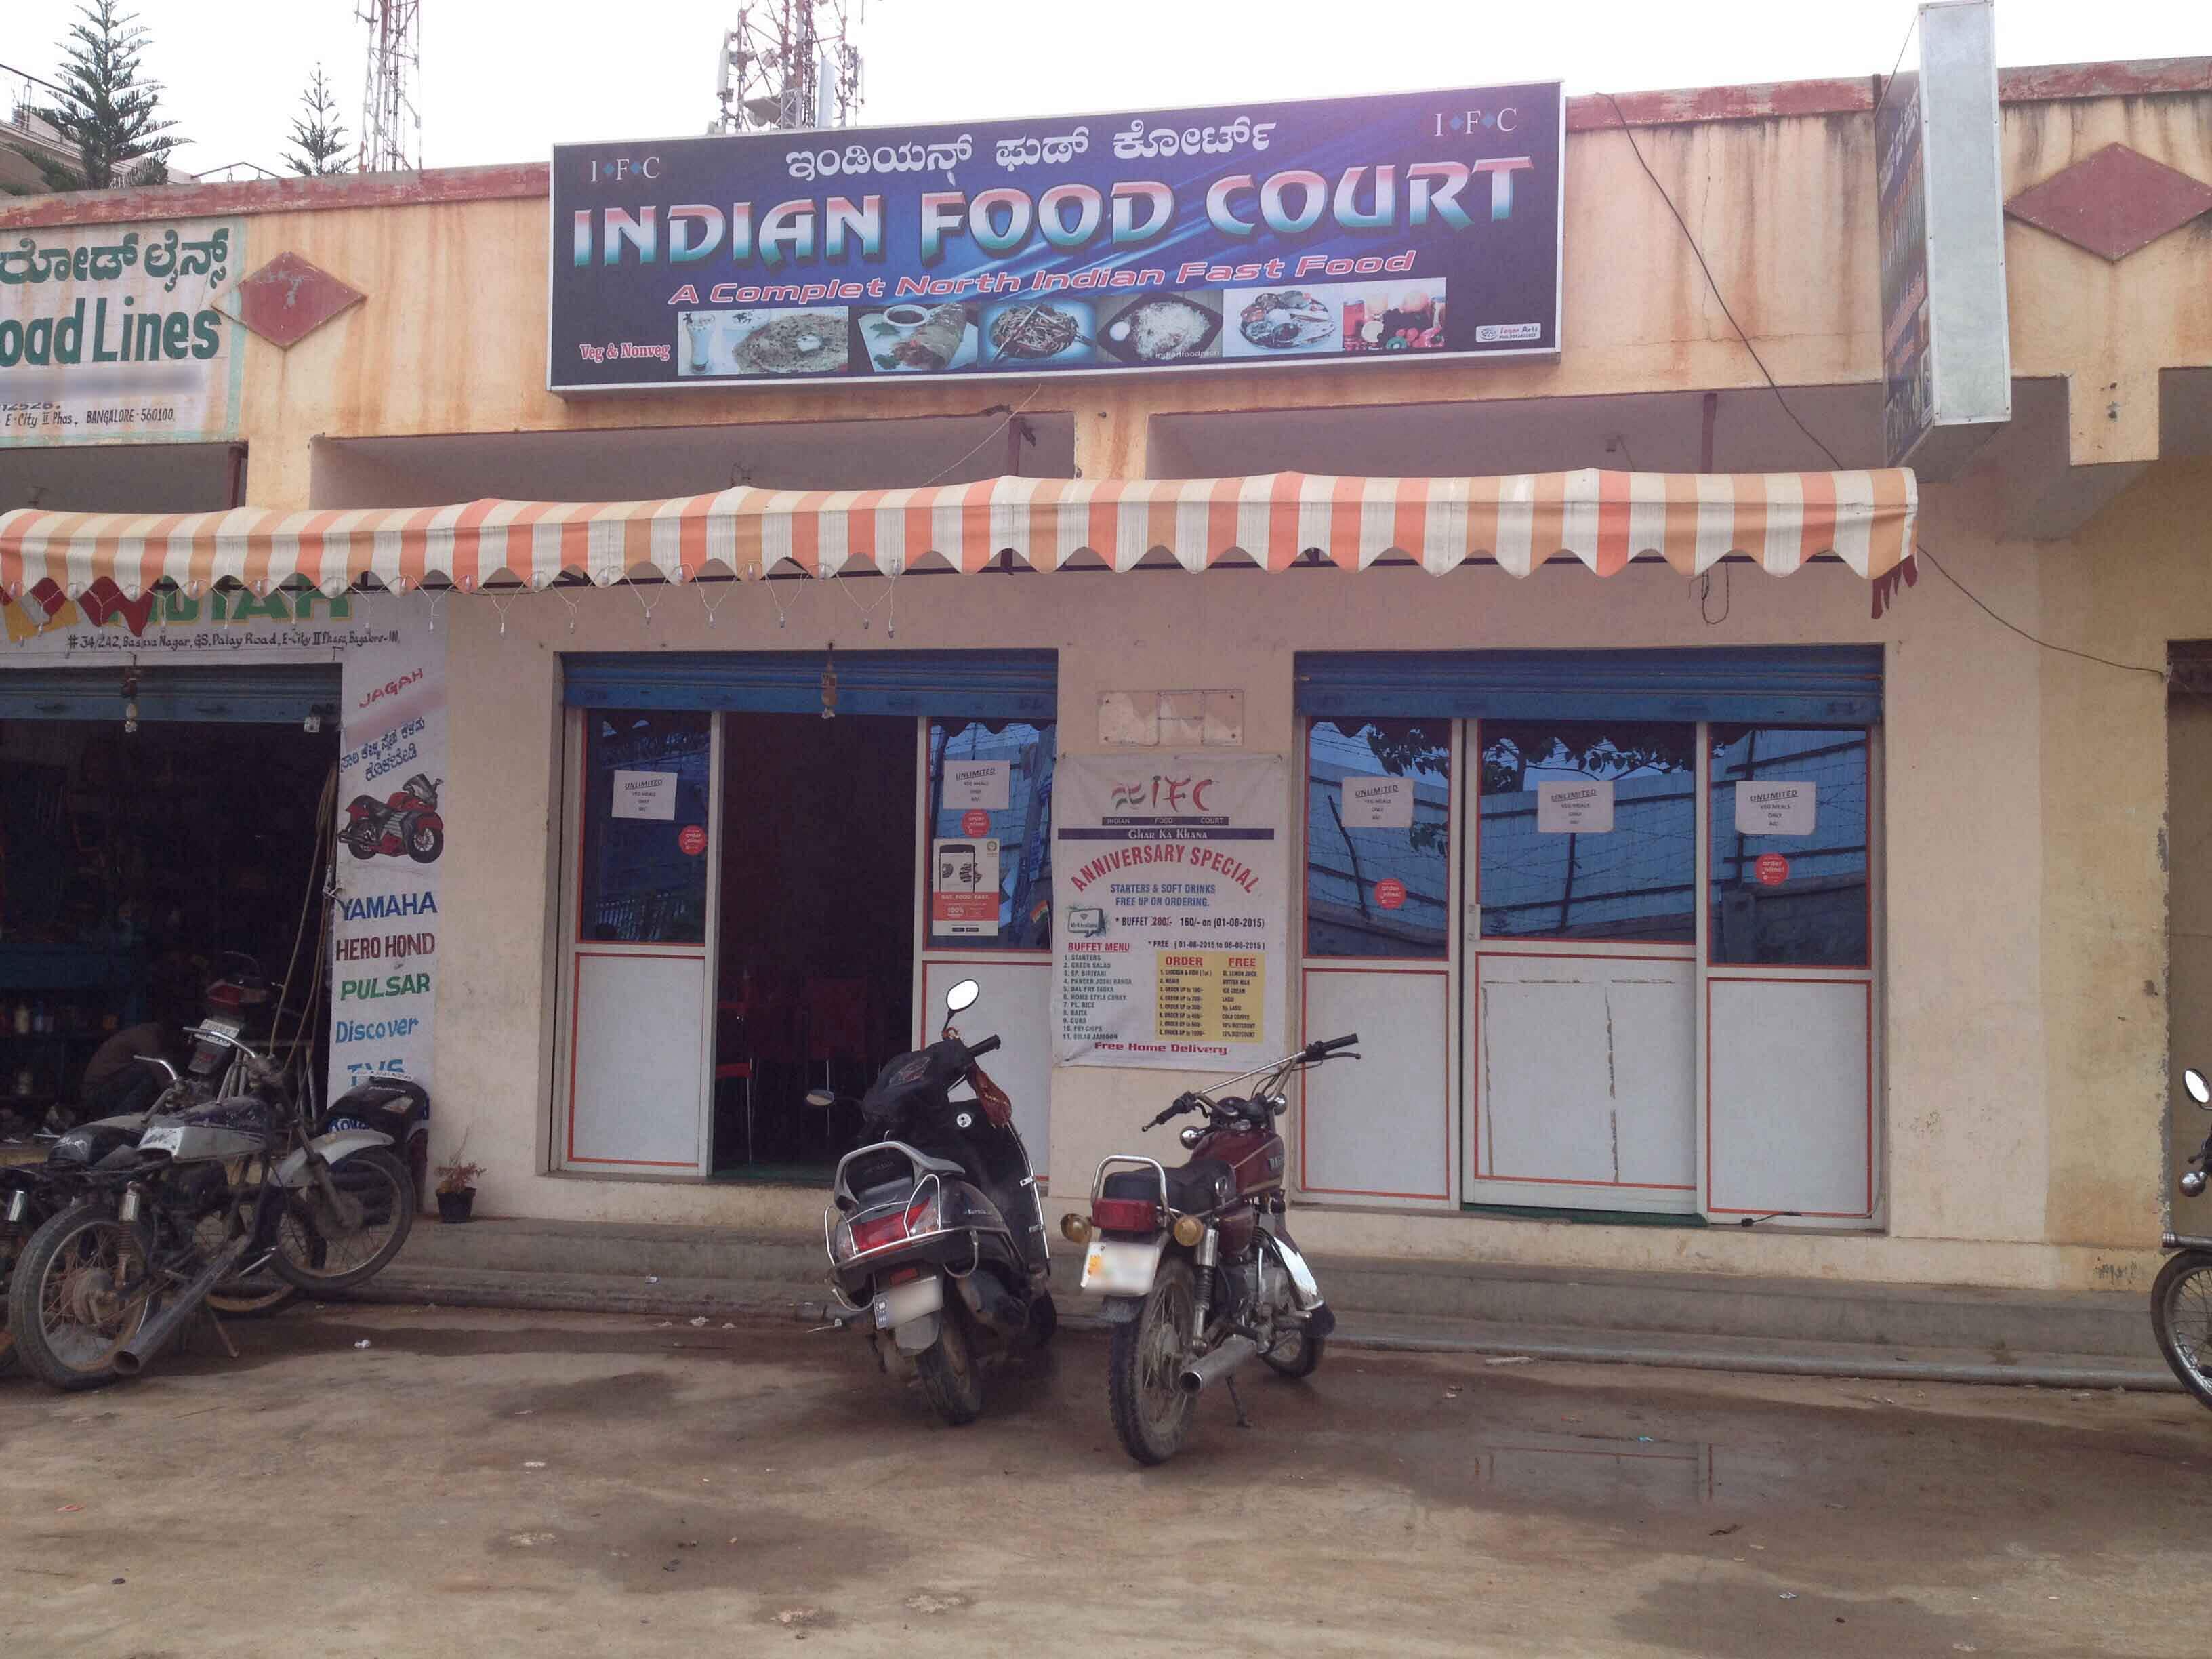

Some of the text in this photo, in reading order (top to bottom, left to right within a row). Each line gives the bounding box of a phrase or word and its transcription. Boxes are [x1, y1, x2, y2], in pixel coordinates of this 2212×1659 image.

[785, 133, 972, 186] ಇಂಡಿಯನ್
[573, 155, 1534, 268] INDIAN FOOD COURT
[668, 251, 1416, 304] A Complet North Indian Fast Food
[93, 295, 222, 363] Lines
[579, 342, 670, 363] Veg & Nonveg
[956, 767, 996, 781] UNLIMITED
[624, 779, 663, 791] UNLIMITED
[1355, 785, 1399, 798] UNLIMITED
[1551, 789, 1597, 802] UNLIMITED
[1750, 790, 1799, 802] UNLIMITED
[1071, 844, 1259, 893] ANNIVERSARY SPECIAL
[1111, 884, 1216, 894] STARTERS & SOFT DRINKS
[337, 890, 438, 921] YAMAHA
[1115, 897, 1210, 907] FREE UP ON ORDERING.
[1122, 916, 1147, 926] BUFFET
[1214, 918, 1265, 929] (01-08-2015)
[336, 933, 435, 961] HERO HOND
[1068, 943, 1130, 951] BUFFET MENU
[1166, 956, 1203, 966] ORDER
[1229, 958, 1256, 966] FREE
[340, 973, 430, 1001] PULSAR
[335, 1017, 419, 1044] Discover
[1095, 1042, 1227, 1056] Free Home Delivery
